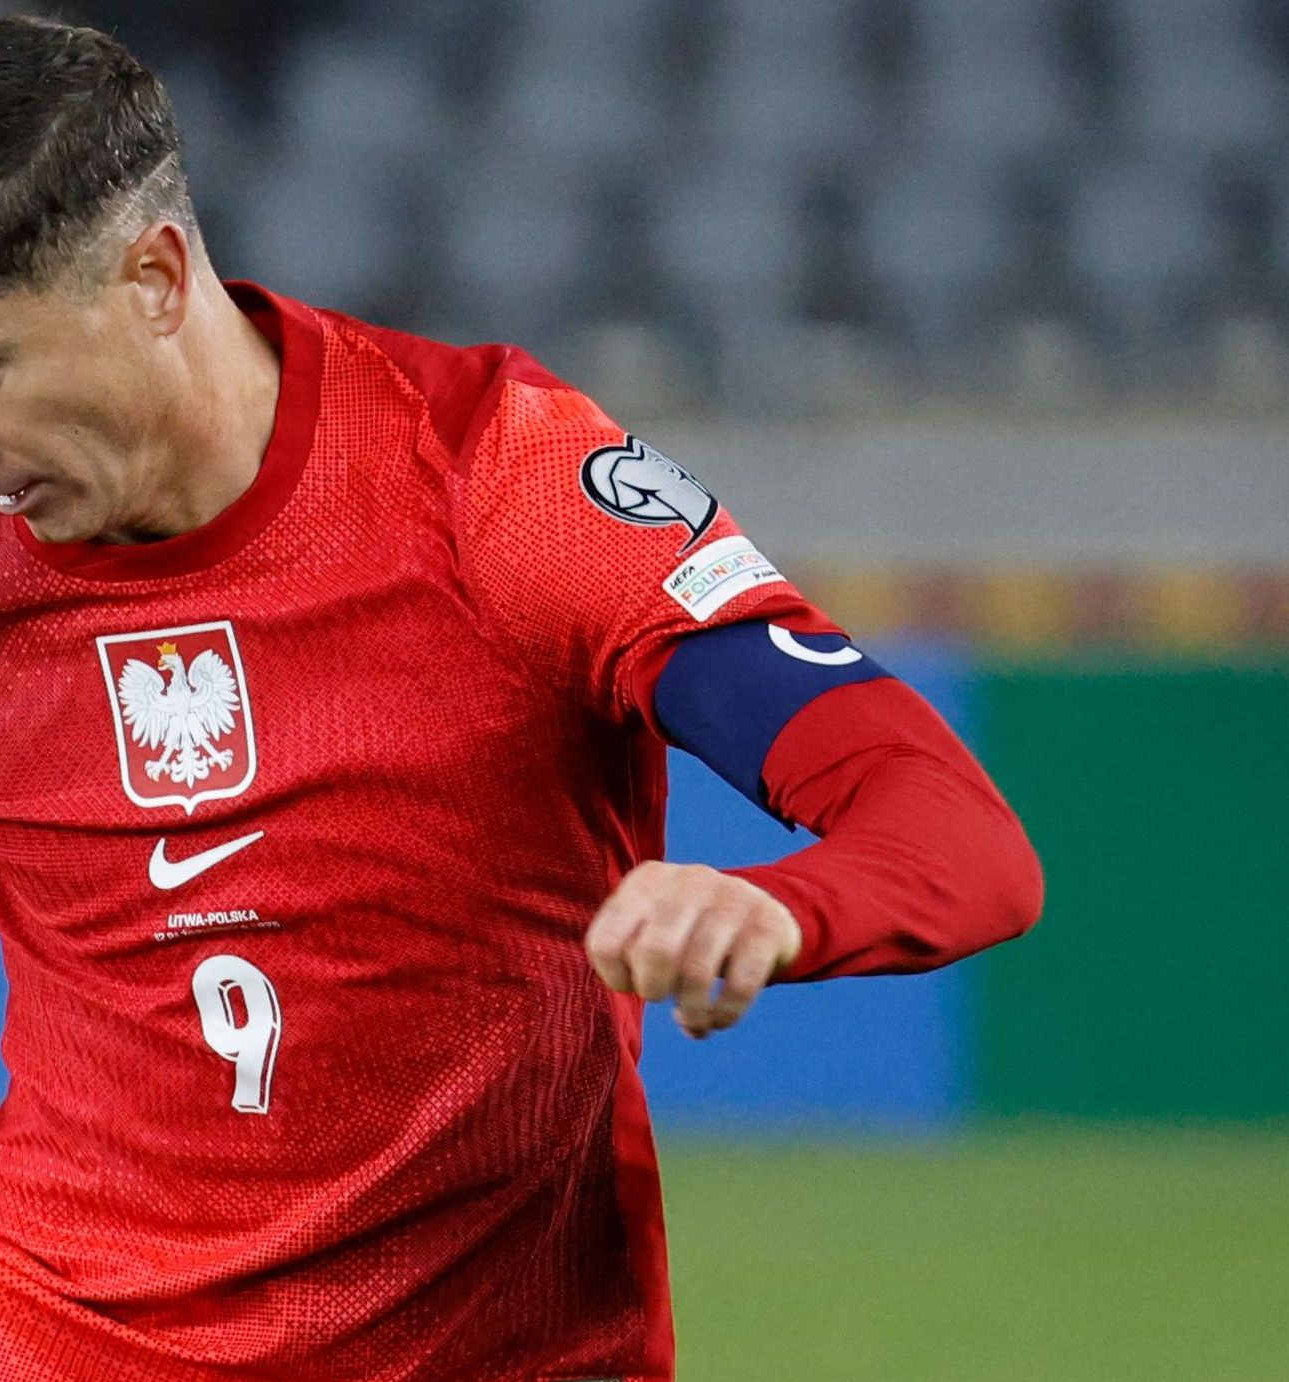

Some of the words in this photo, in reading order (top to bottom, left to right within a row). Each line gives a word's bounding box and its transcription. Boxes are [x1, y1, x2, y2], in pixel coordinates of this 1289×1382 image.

[670, 565, 696, 590] UEFA
[167, 909, 260, 929] LITWA-POLSKA
[192, 953, 282, 1114] 9
